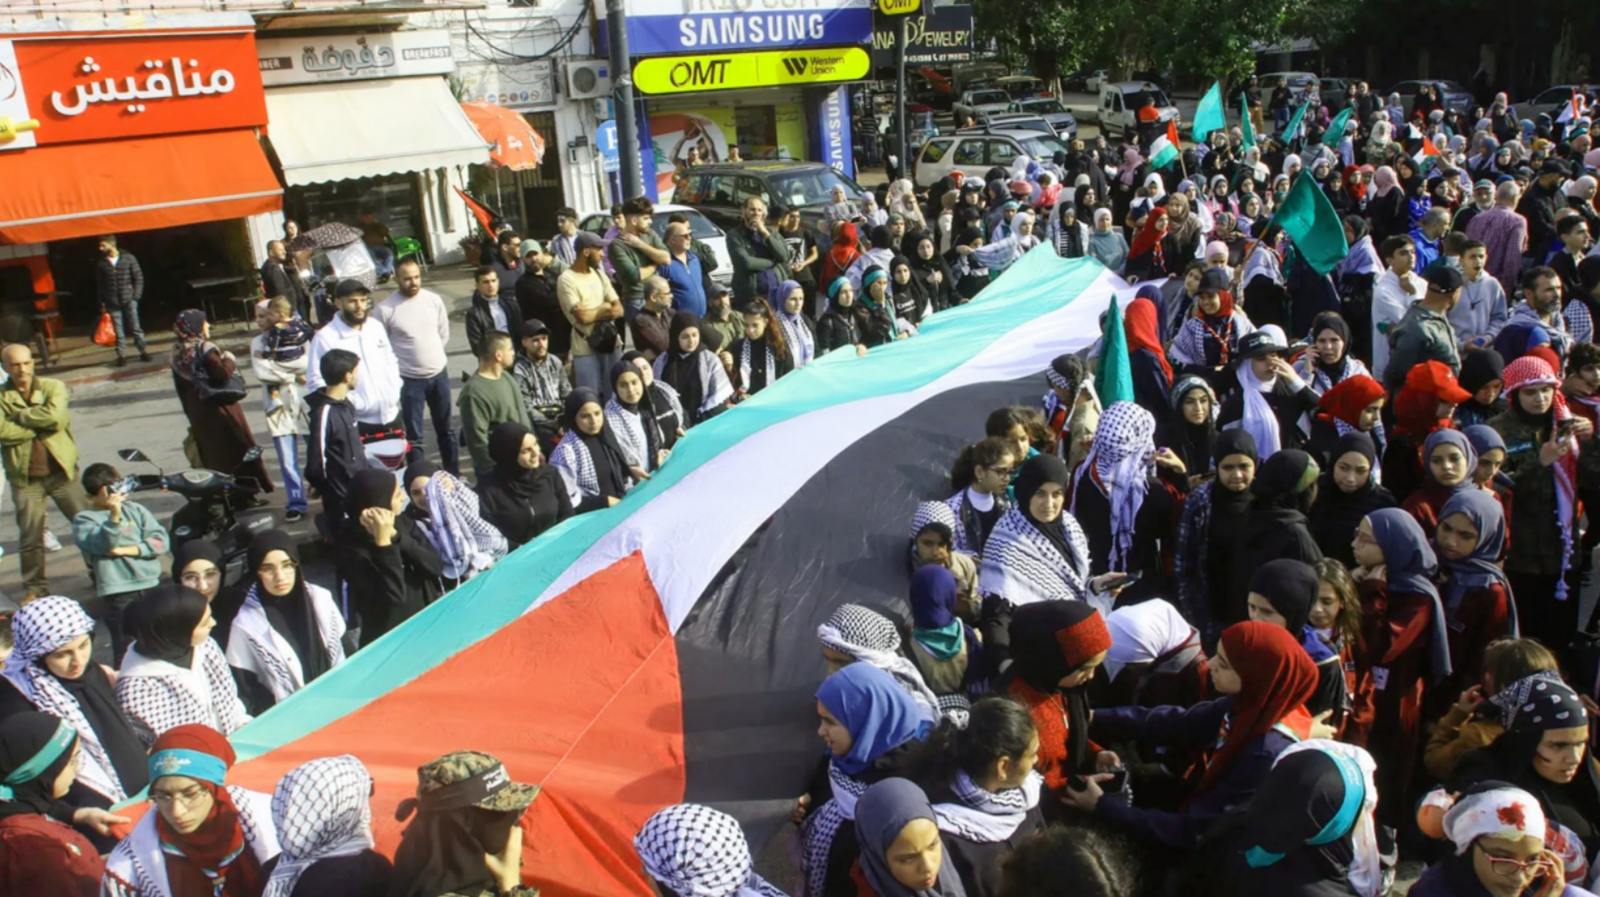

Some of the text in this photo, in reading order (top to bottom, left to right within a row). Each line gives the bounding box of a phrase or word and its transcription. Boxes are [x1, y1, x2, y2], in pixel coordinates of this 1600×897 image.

[679, 14, 824, 46] SAMSUNG
[403, 48, 450, 60] BREAKFAST
[810, 56, 845, 66] Western
[669, 59, 732, 87] OMT
[810, 65, 836, 76] Union
[51, 56, 235, 116] مناقيش
